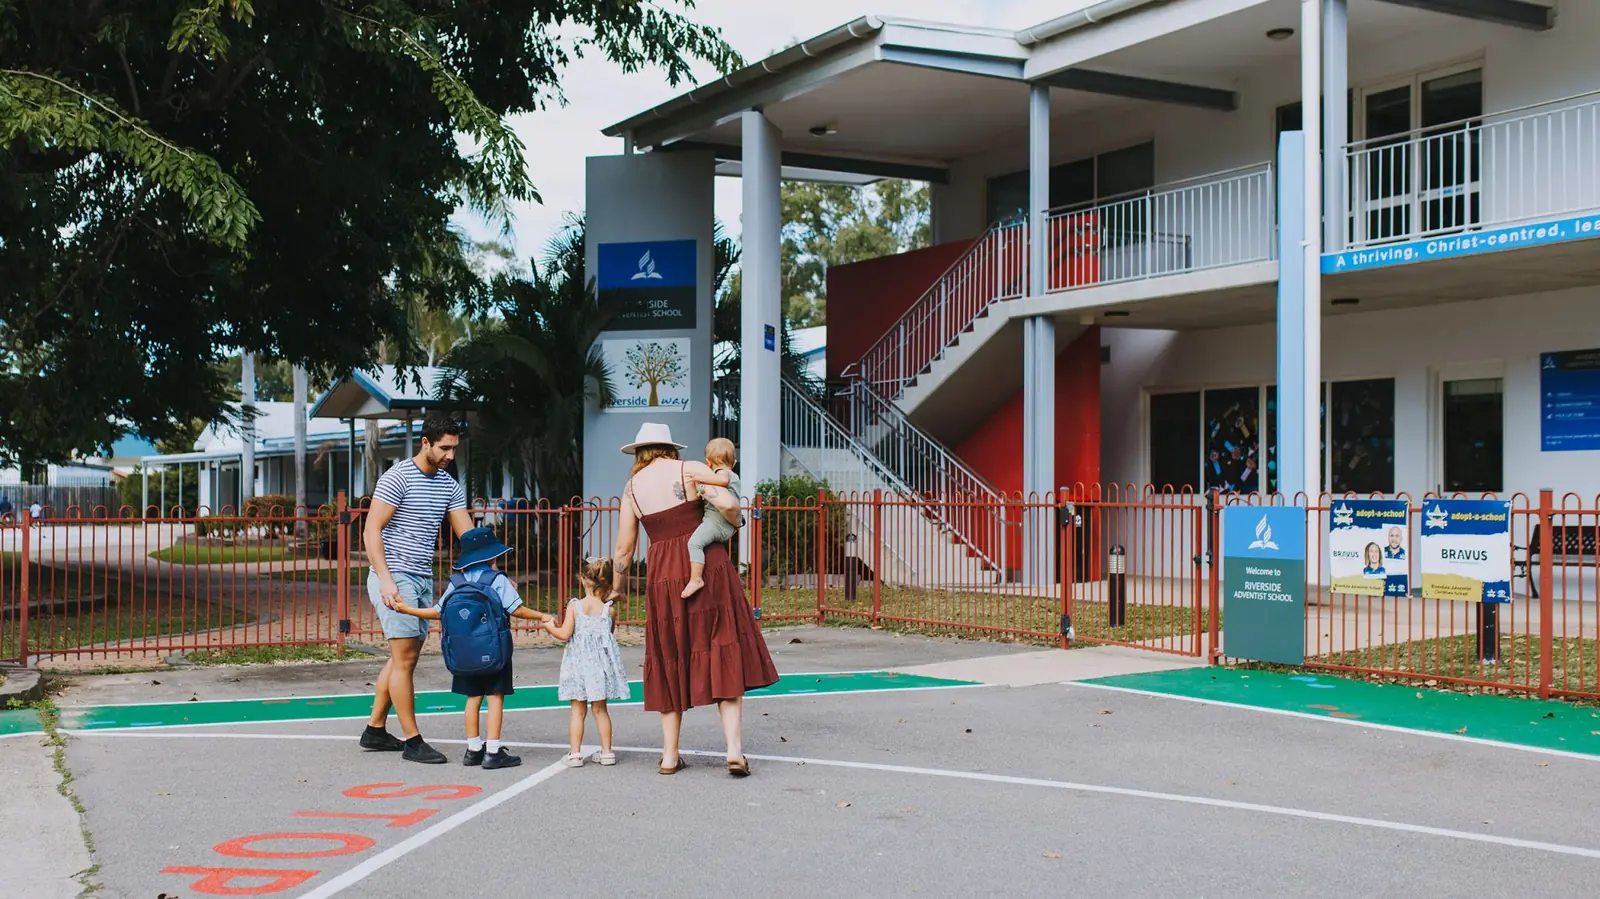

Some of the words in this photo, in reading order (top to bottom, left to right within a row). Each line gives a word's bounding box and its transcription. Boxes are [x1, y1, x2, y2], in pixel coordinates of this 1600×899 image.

[1336, 255, 1346, 267] A
[1352, 245, 1419, 265] thriving,
[1426, 223, 1566, 254] Christ-centred,
[652, 308, 683, 317] SCHOOL
[661, 398, 689, 411] way
[1356, 508, 1405, 519] adopt-a-school
[1451, 511, 1506, 522] adopt-a-school
[1333, 550, 1360, 558] BRAVUS
[1441, 548, 1488, 561] BRAVUS
[1246, 566, 1274, 577] Welcome
[1274, 569, 1281, 577] to
[1244, 581, 1282, 592] RIVERSIDE
[1233, 590, 1267, 601] ADVENTIST
[1267, 592, 1294, 602] SCHOOL
[158, 782, 484, 896] STOP
